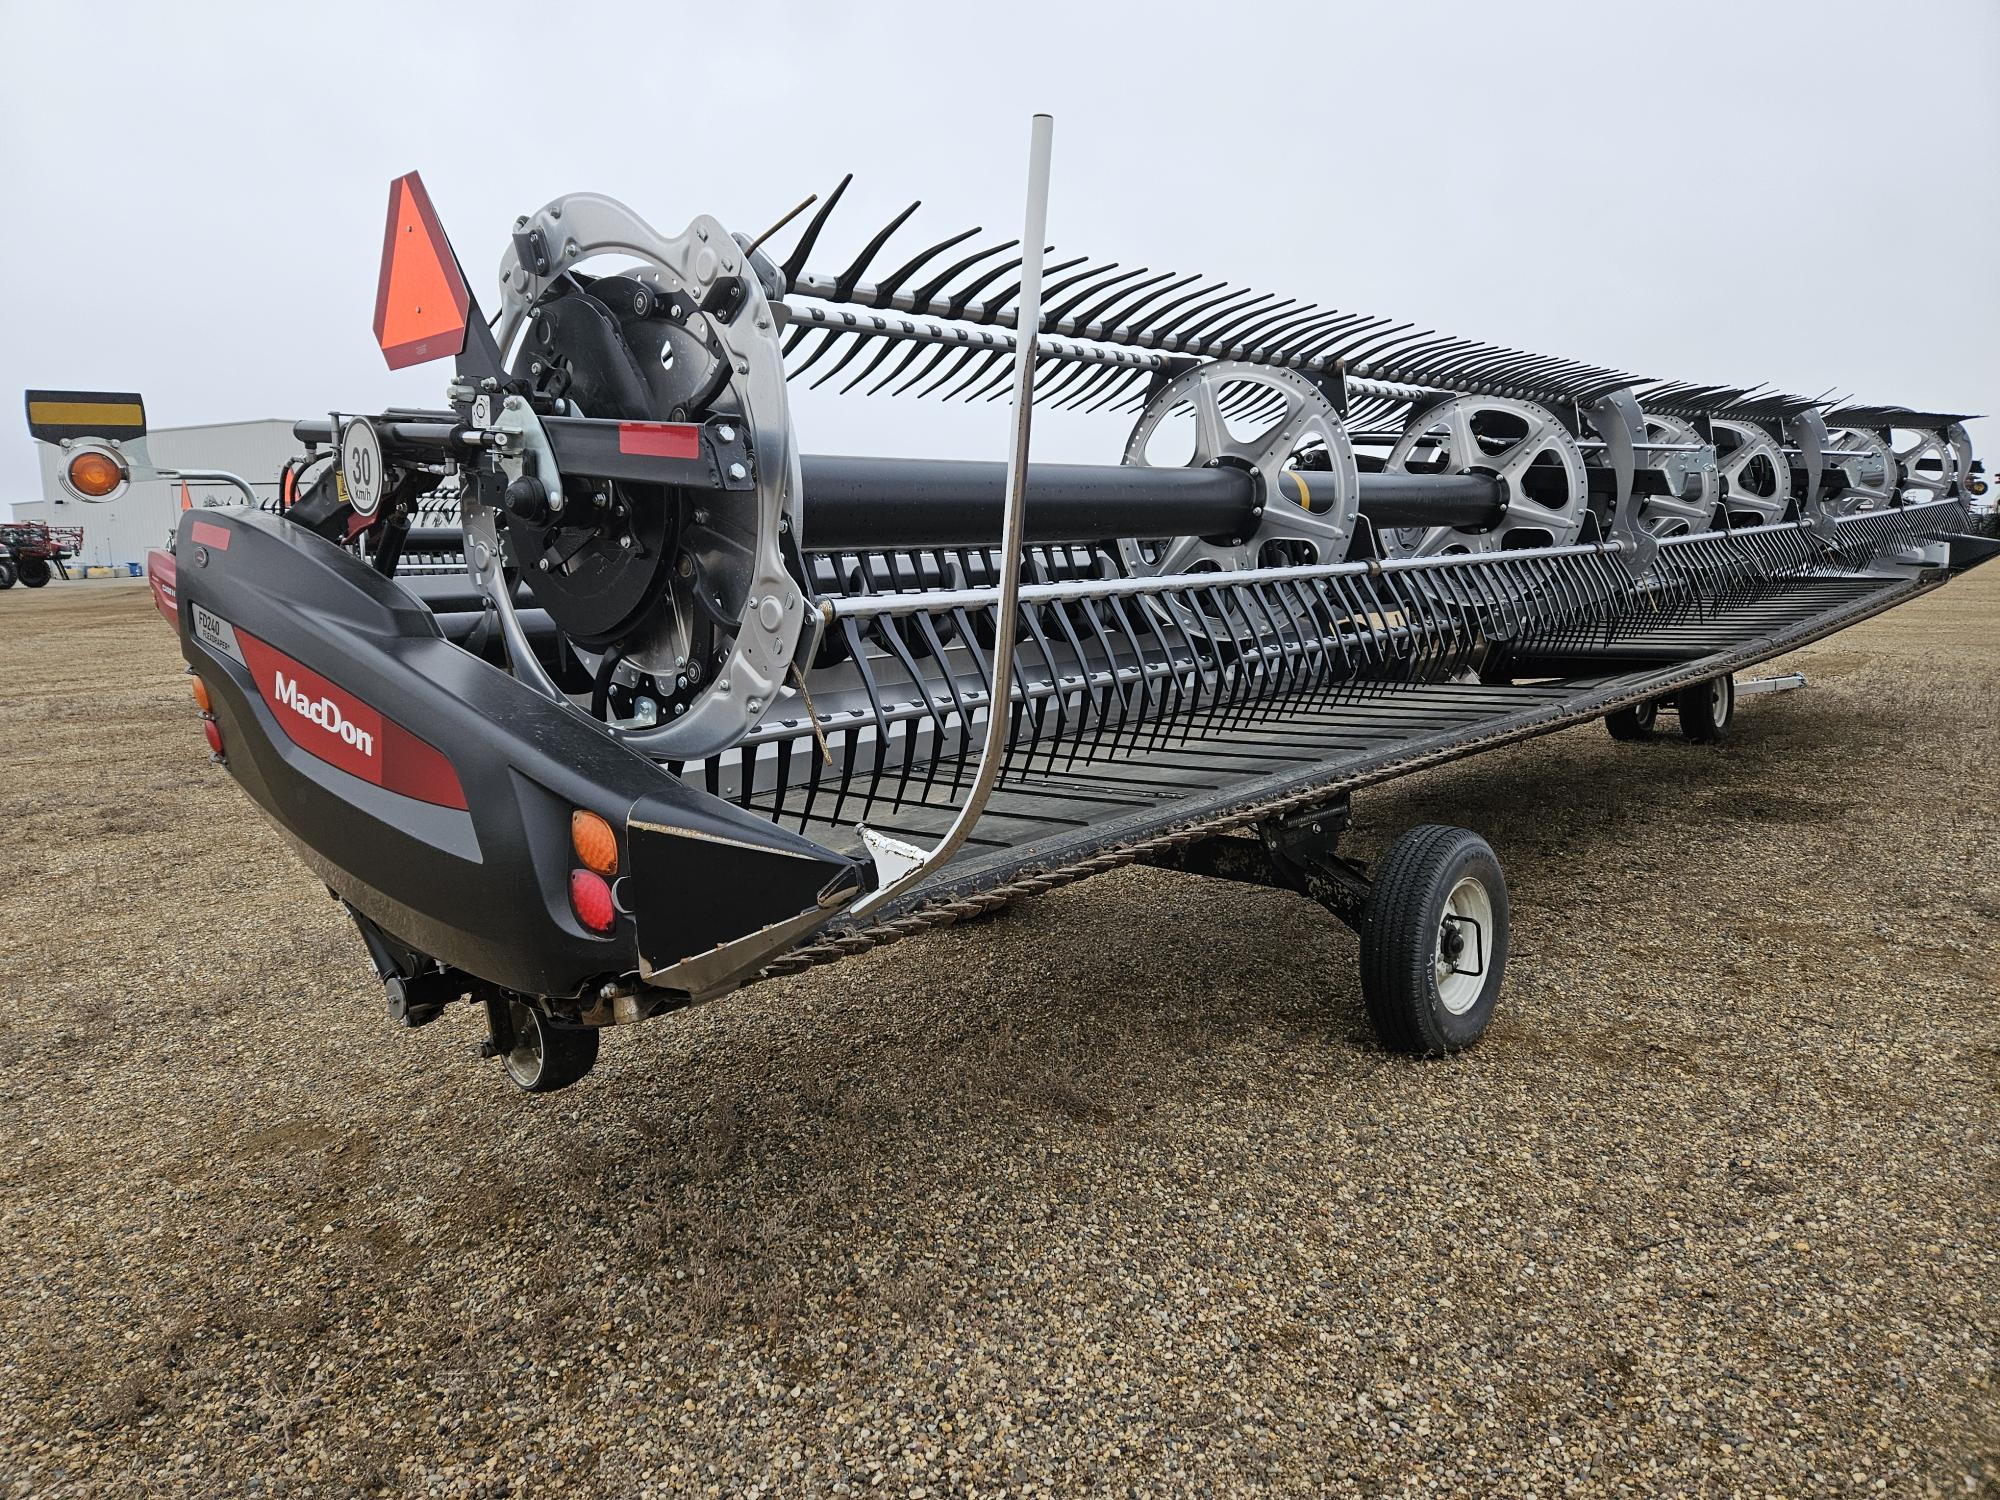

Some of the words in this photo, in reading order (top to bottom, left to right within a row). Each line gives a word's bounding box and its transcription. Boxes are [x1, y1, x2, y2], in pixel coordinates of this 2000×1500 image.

[352, 446, 371, 486] 30
[354, 486, 372, 502] km/h
[198, 610, 220, 636] FD240
[274, 670, 373, 757] MacDon
